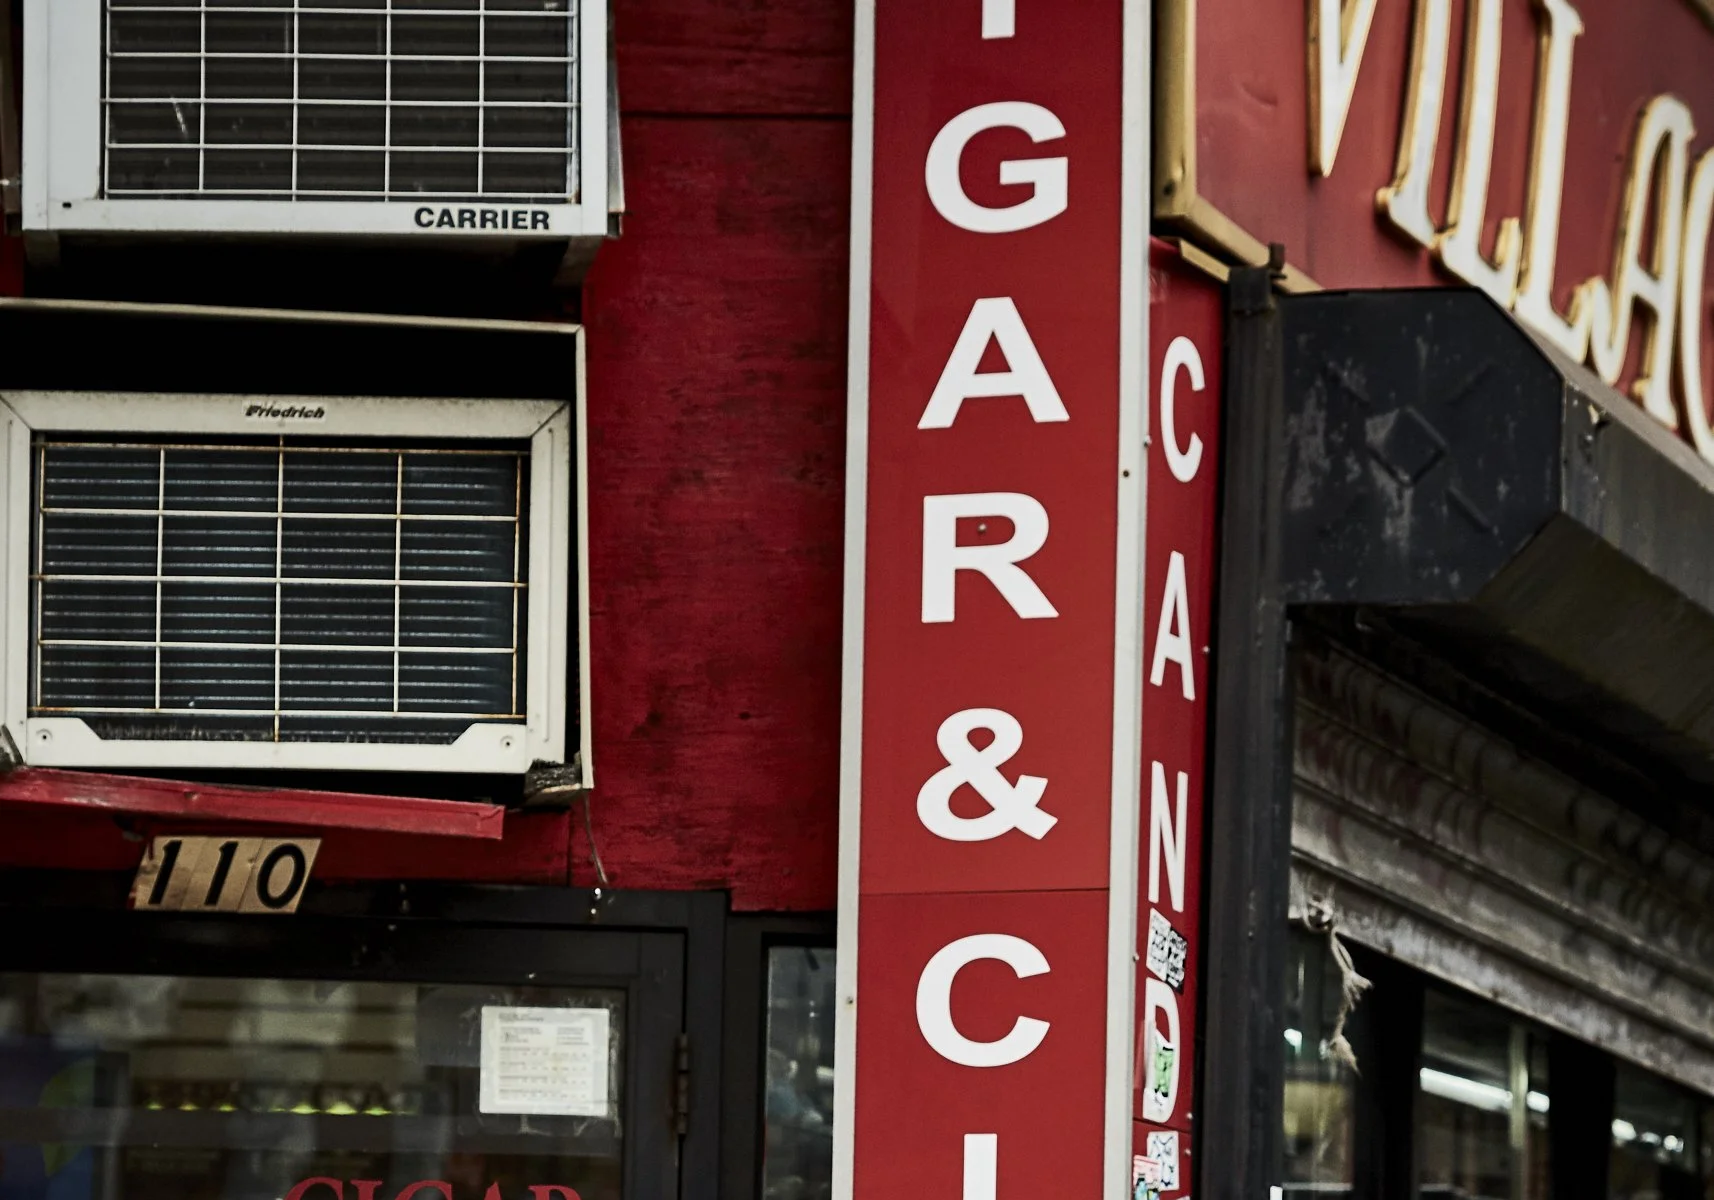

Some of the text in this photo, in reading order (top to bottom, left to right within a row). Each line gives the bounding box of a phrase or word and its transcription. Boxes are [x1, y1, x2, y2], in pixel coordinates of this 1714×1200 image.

[414, 206, 550, 231] CARRIER
[917, 0, 1069, 623] GAR
[245, 404, 325, 420] Friedrich
[917, 707, 1057, 842] &
[148, 839, 306, 910] 110
